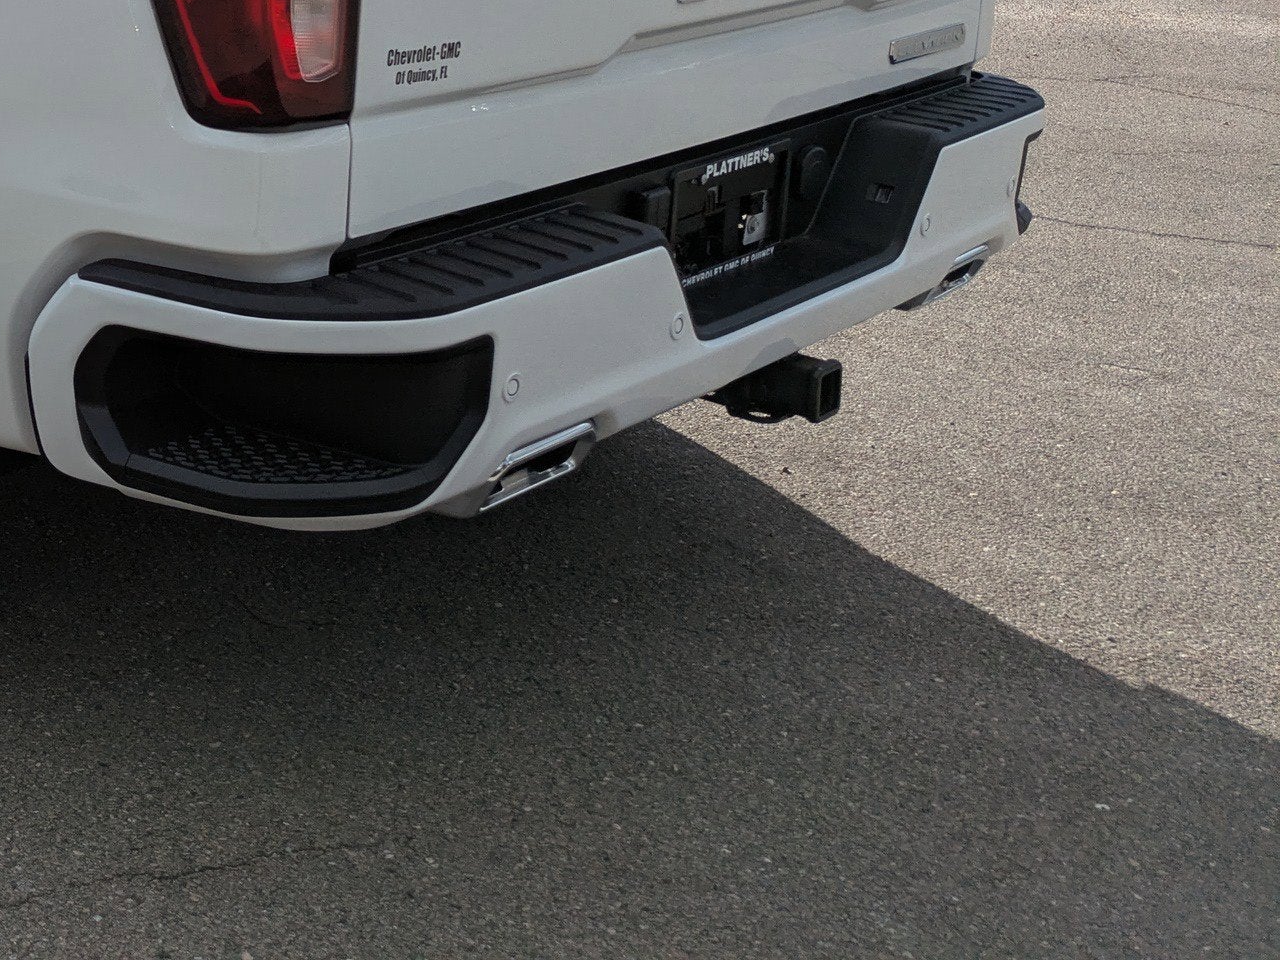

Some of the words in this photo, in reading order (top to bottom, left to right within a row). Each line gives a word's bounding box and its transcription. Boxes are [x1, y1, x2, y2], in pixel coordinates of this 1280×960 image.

[386, 41, 461, 67] Chevrolet-GMC
[395, 71, 405, 85] Of
[406, 68, 438, 85] Quincy,
[439, 65, 448, 79] FL
[706, 147, 770, 178] PLATTNER'S
[681, 265, 723, 288] CHEVROLET
